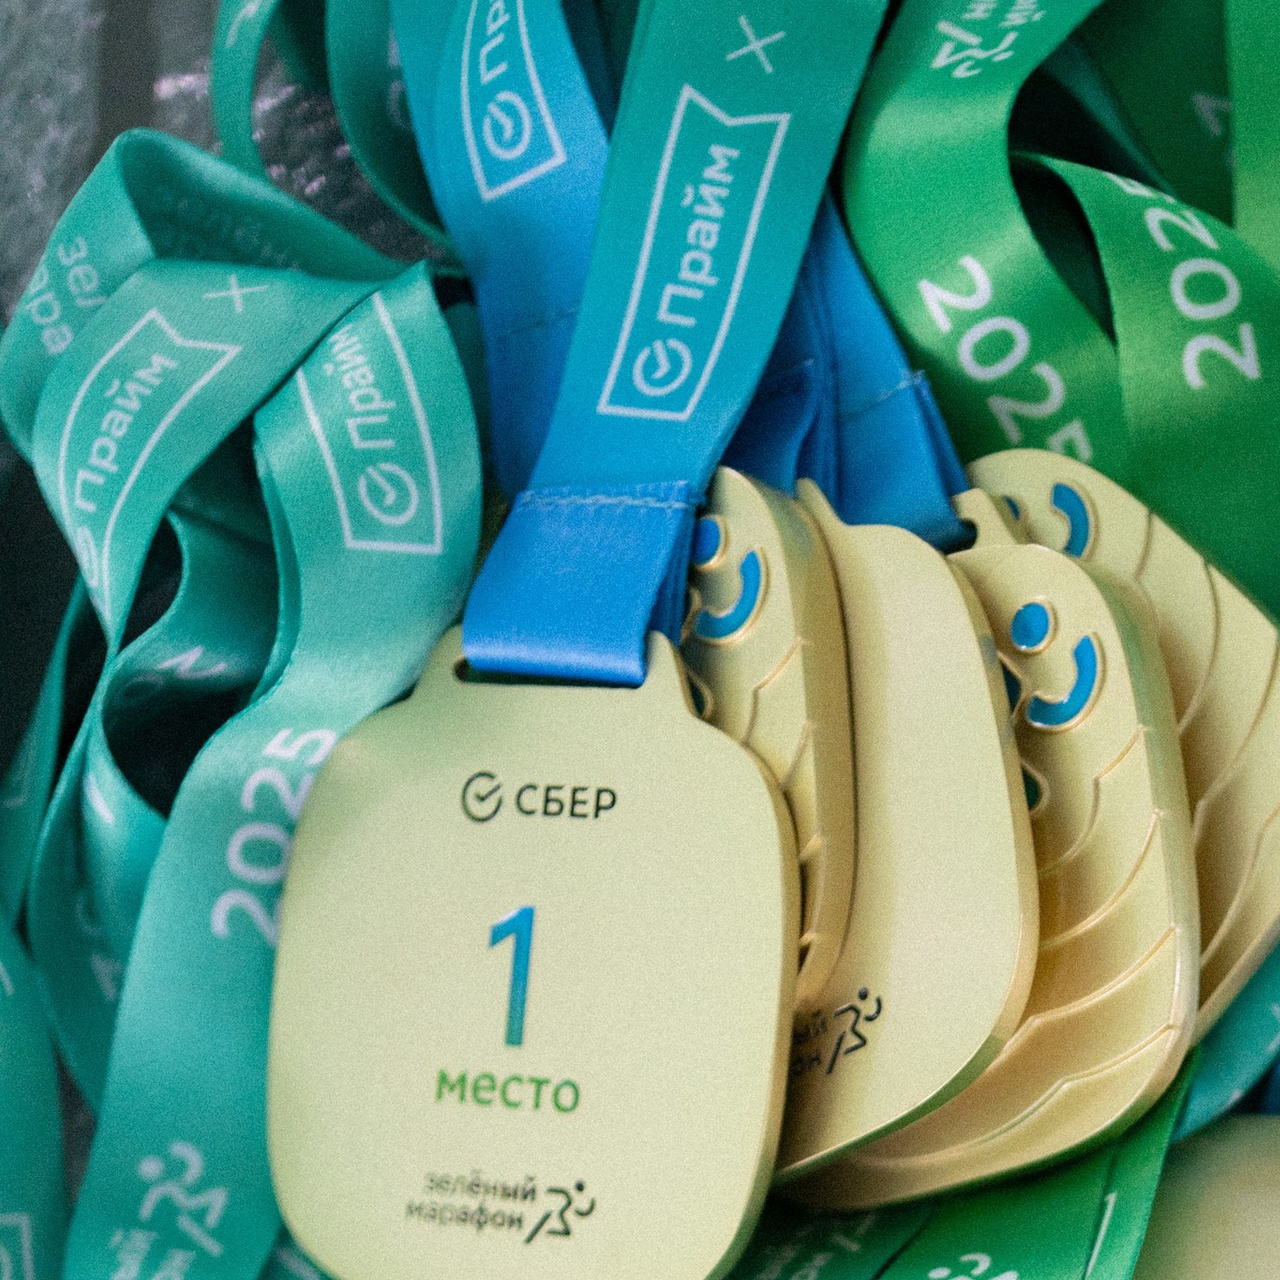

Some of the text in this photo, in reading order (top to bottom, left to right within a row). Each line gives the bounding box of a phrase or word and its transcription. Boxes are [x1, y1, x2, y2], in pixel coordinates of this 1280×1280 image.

[654, 143, 740, 328] Прайм
[328, 325, 397, 450] Прайм
[74, 352, 179, 513] Прайм
[514, 781, 620, 821] СБЕР
[486, 904, 538, 1048] 1
[436, 1067, 582, 1113] место
[404, 1199, 526, 1232] марафон
[422, 1168, 538, 1204] зелёный
